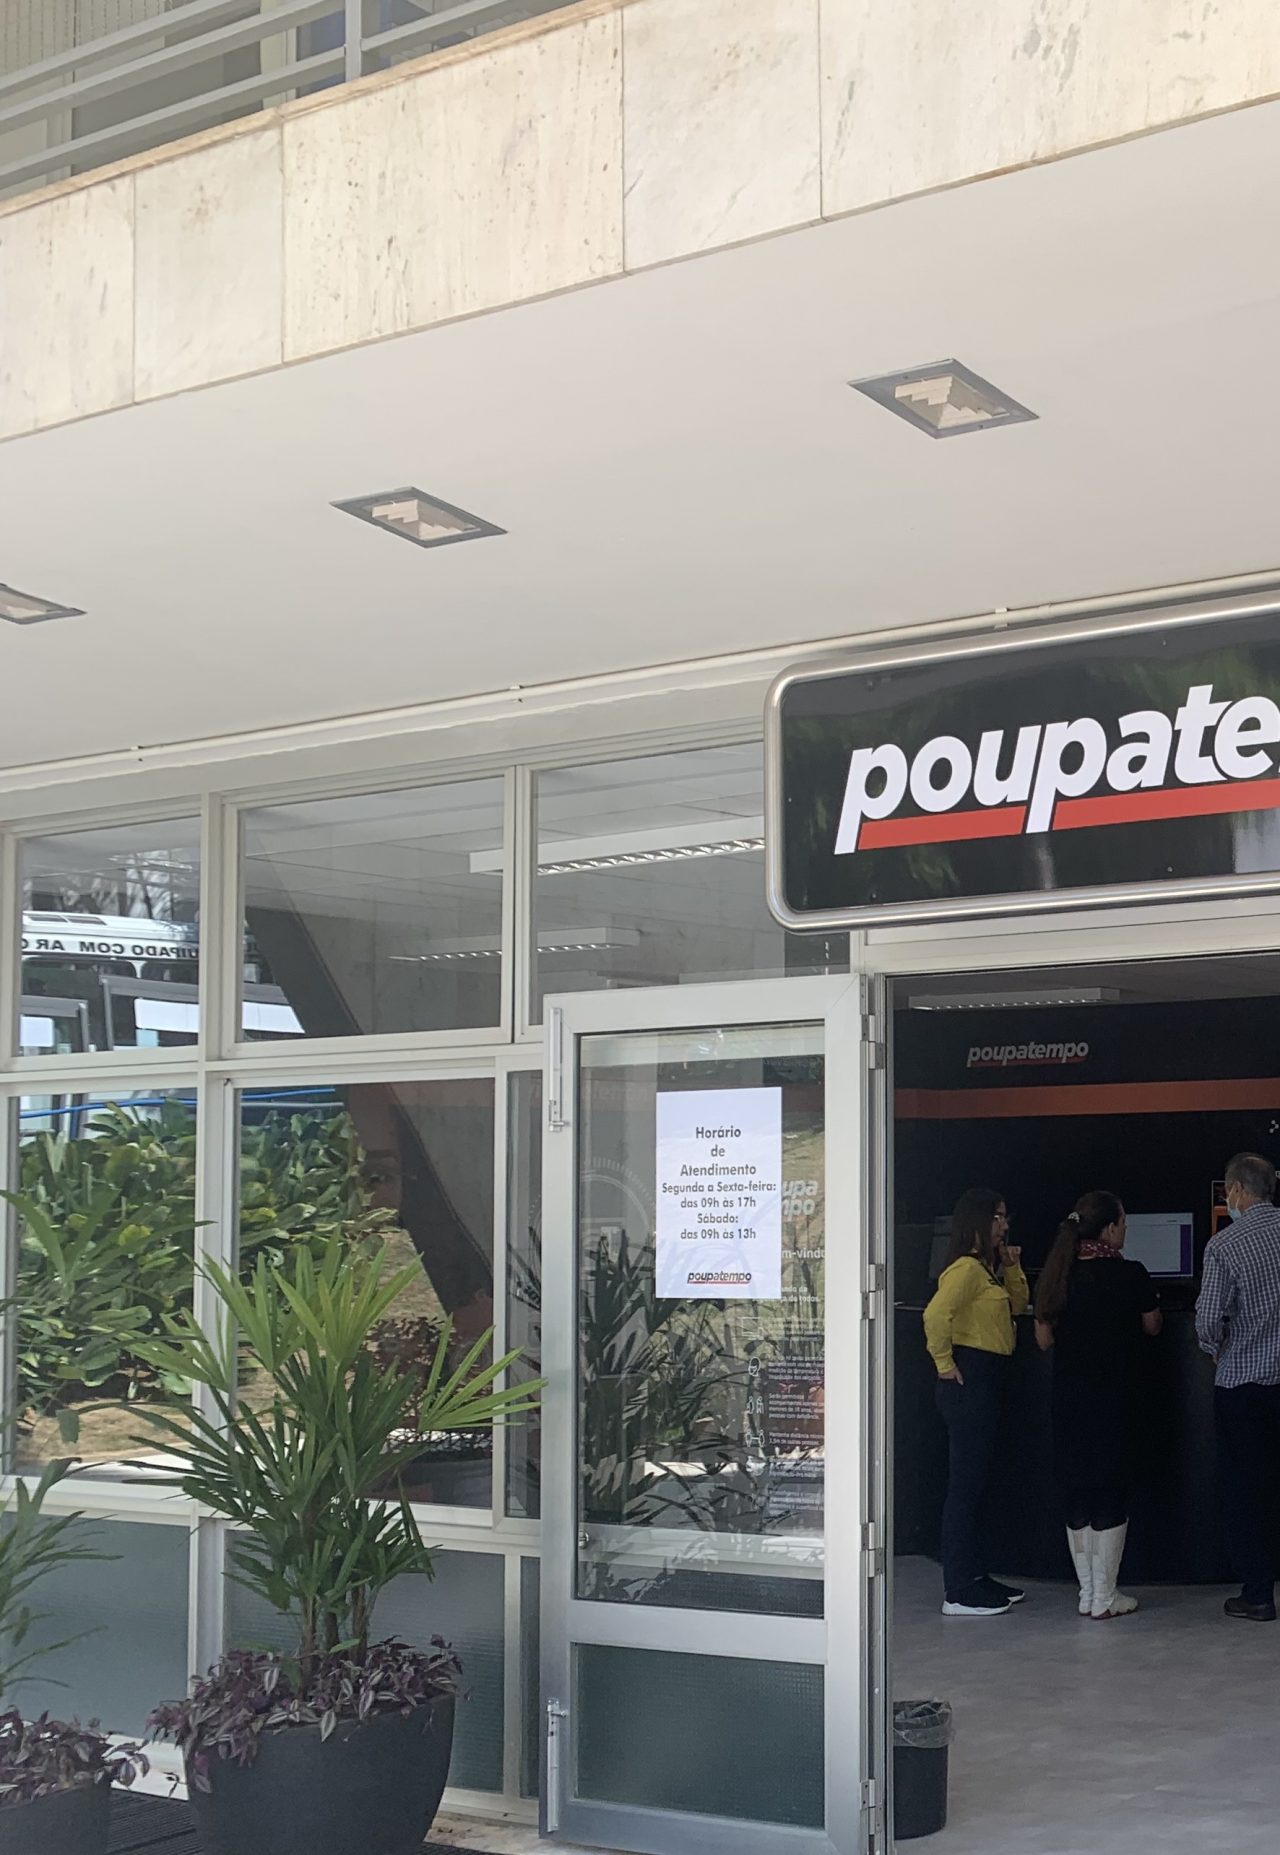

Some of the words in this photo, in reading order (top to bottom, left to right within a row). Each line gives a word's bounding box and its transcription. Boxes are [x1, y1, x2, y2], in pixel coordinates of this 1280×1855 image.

[966, 1041, 1089, 1068] poupatempo
[695, 1125, 742, 1139] Horário
[710, 1144, 726, 1157] de
[680, 1163, 757, 1176] Atendimento
[661, 1181, 705, 1196] Segunda
[707, 1184, 714, 1192] a
[716, 1180, 777, 1193] Sexta-feira:
[680, 1197, 698, 1208] das
[700, 1197, 719, 1208] 09h
[722, 1197, 734, 1208] às
[737, 1196, 756, 1208] 17h
[697, 1212, 739, 1224] Sábado:
[680, 1228, 698, 1239] das
[700, 1228, 719, 1239] 09h
[722, 1228, 734, 1239] às
[737, 1228, 756, 1239] 13h
[687, 1271, 752, 1284] poupatempo
